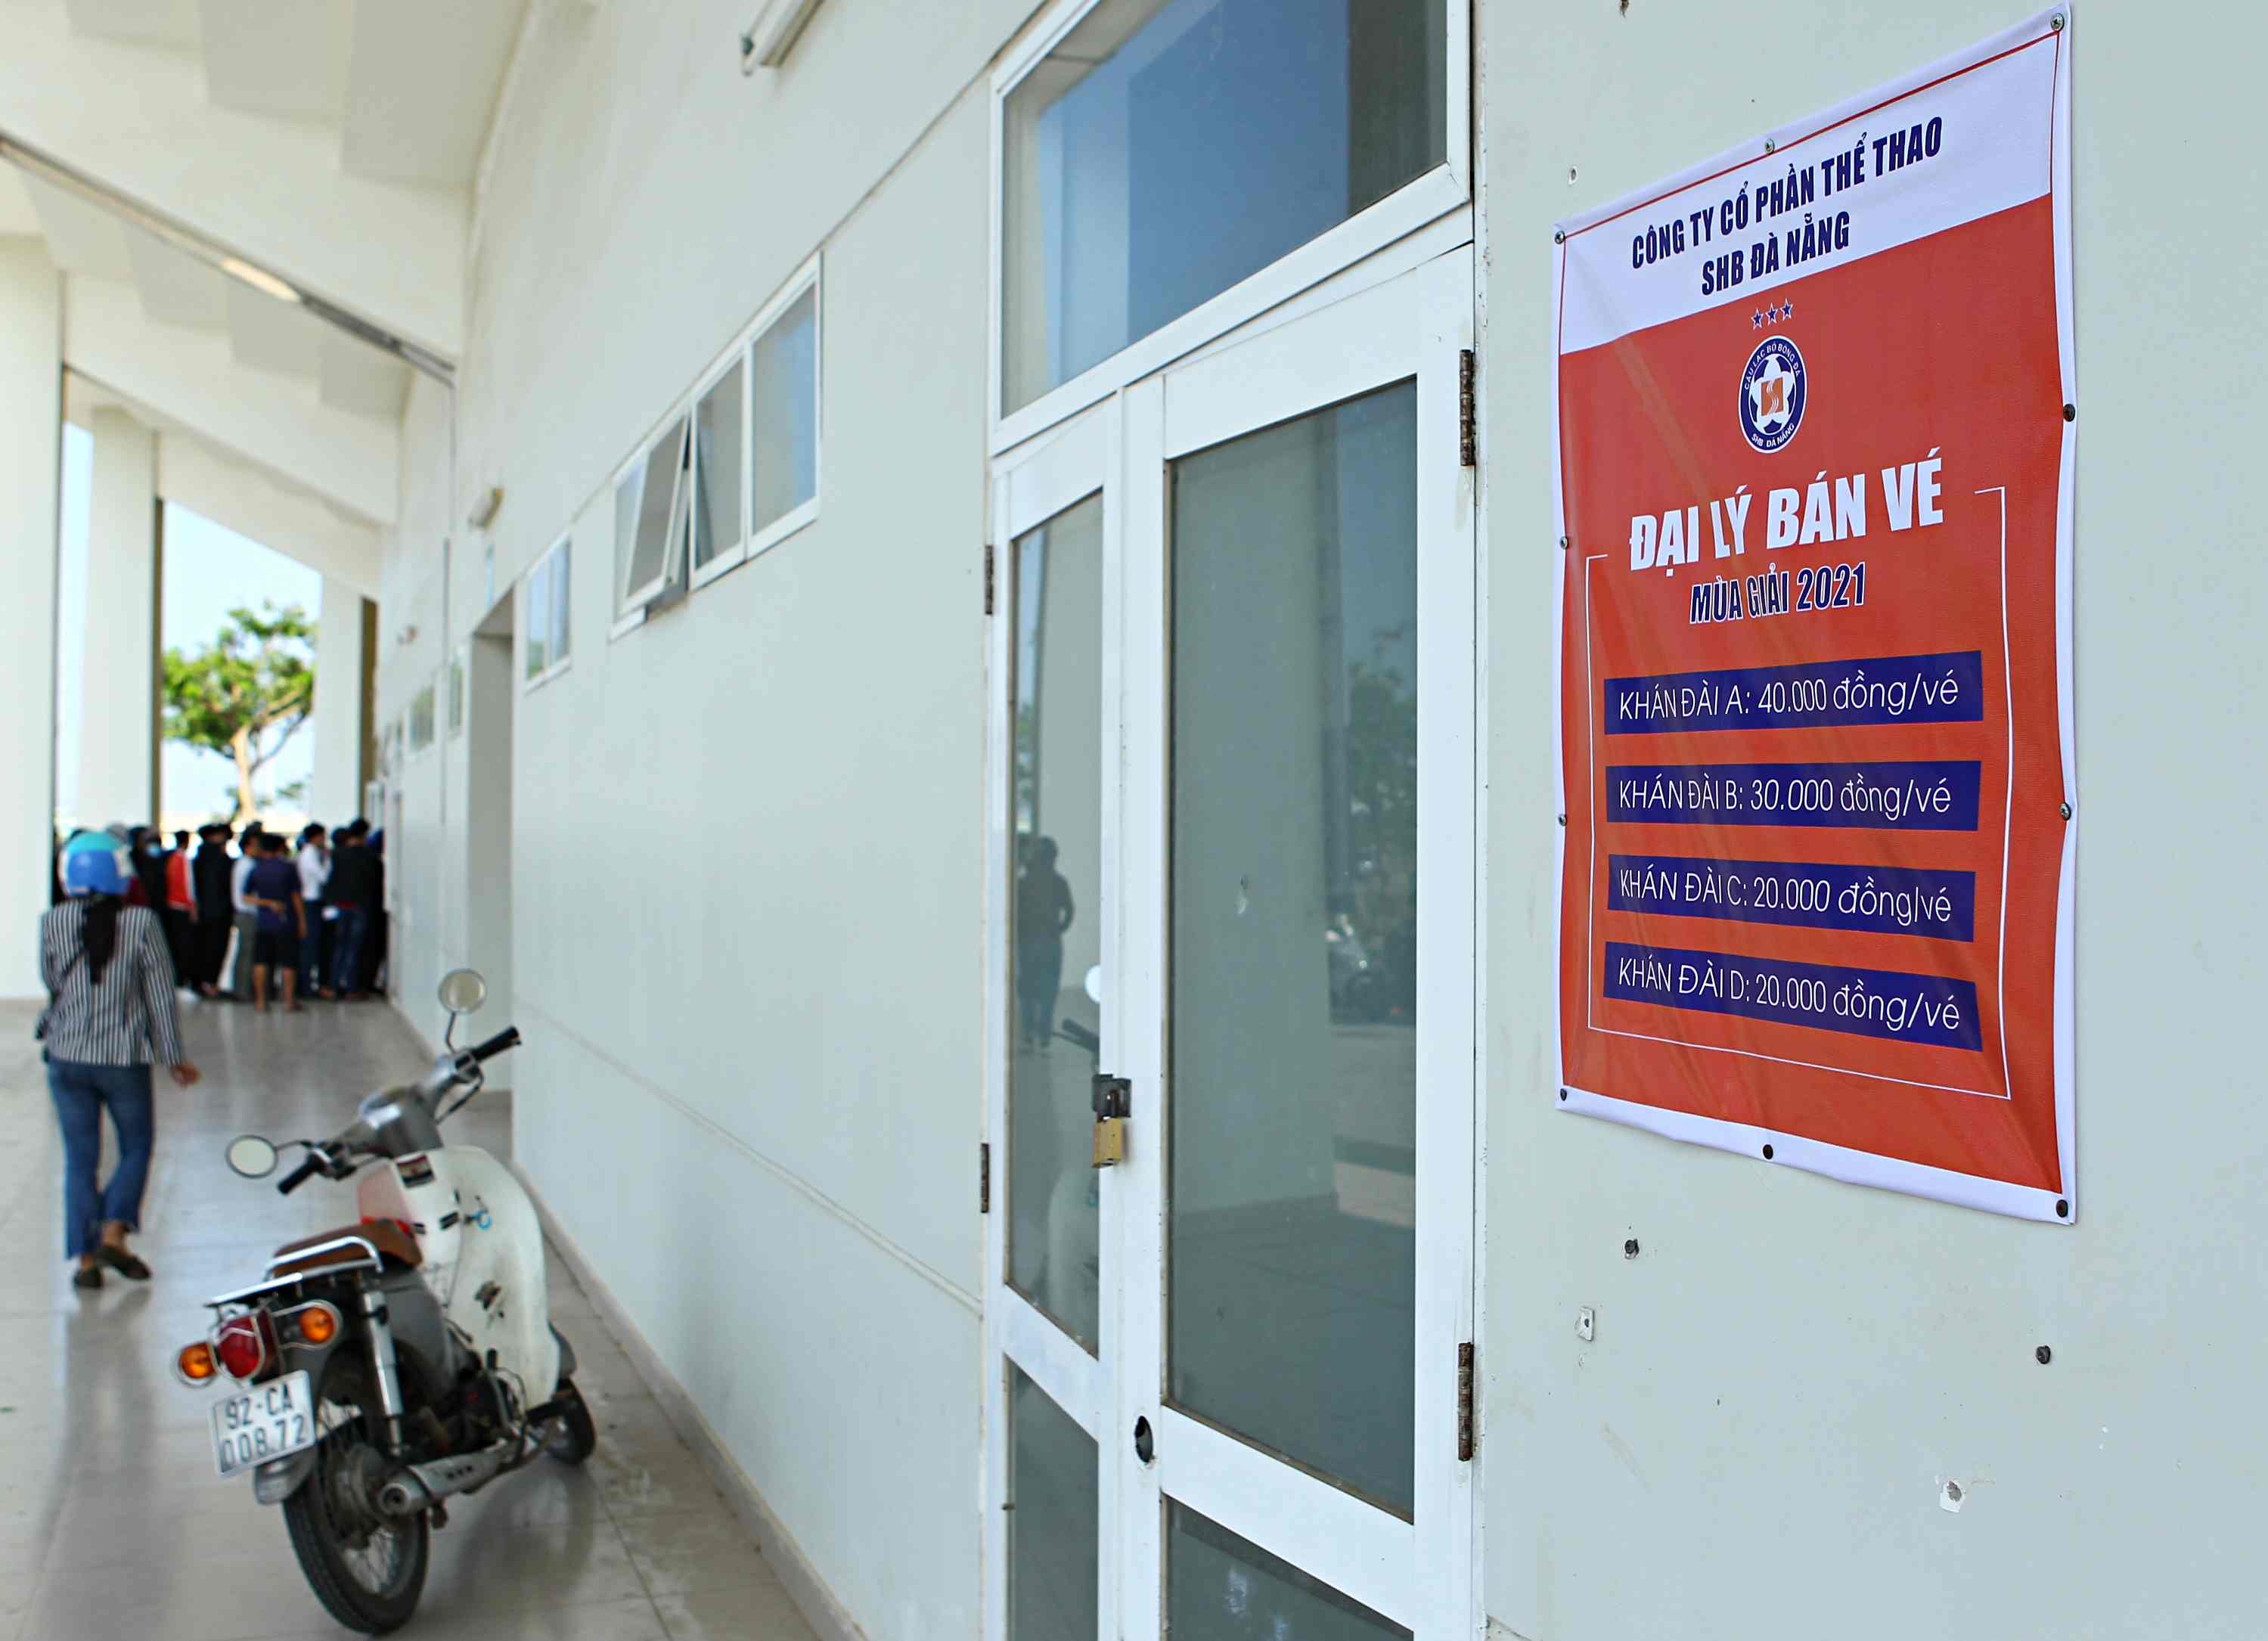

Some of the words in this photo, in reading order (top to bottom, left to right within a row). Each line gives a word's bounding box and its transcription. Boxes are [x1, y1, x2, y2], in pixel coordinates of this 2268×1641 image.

[1633, 219, 1686, 268] CÔNG
[1690, 206, 1714, 247] TY
[1720, 180, 1748, 236] CỔ
[1755, 163, 1814, 223] PHẦN
[1821, 132, 1867, 197] THỂ
[1873, 116, 1942, 177] THAO
[1702, 250, 1743, 296] SHB
[1751, 232, 1779, 279] ĐÀ
[1786, 211, 1850, 267] NẴNG
[1751, 433, 1764, 447] SHB
[1629, 506, 1699, 576] ĐẠI
[1710, 484, 1752, 560] LÝ
[1767, 470, 1866, 549] BÁN
[1881, 446, 1944, 532] VÉ
[1689, 574, 1743, 624] MÙA
[1746, 563, 1789, 619] GIẢI
[1796, 562, 1866, 611] 2021
[1619, 684, 1677, 720] KHÁN
[1681, 680, 1719, 718] ĐÀI
[1725, 686, 1751, 715] A:
[1758, 678, 1827, 714] 40.000
[1833, 669, 1959, 715] đồng/vé
[1619, 773, 1683, 811] KHÁN
[1688, 773, 1720, 810] ĐÀI
[1727, 780, 1743, 810] B:
[1750, 779, 1833, 812] 30.000
[1840, 773, 1951, 821] đồng/vé
[1620, 864, 1677, 901] KHÁN
[1685, 866, 1722, 904] ĐÀI
[1727, 874, 1748, 907] C:
[1754, 876, 1831, 913] 20.000
[1618, 954, 1672, 992] KHÁN
[1678, 959, 1723, 998] ĐÀI
[1731, 969, 1750, 1002] D:
[1755, 973, 1826, 1013] 20.000
[1833, 979, 1960, 1031] đồng/vé
